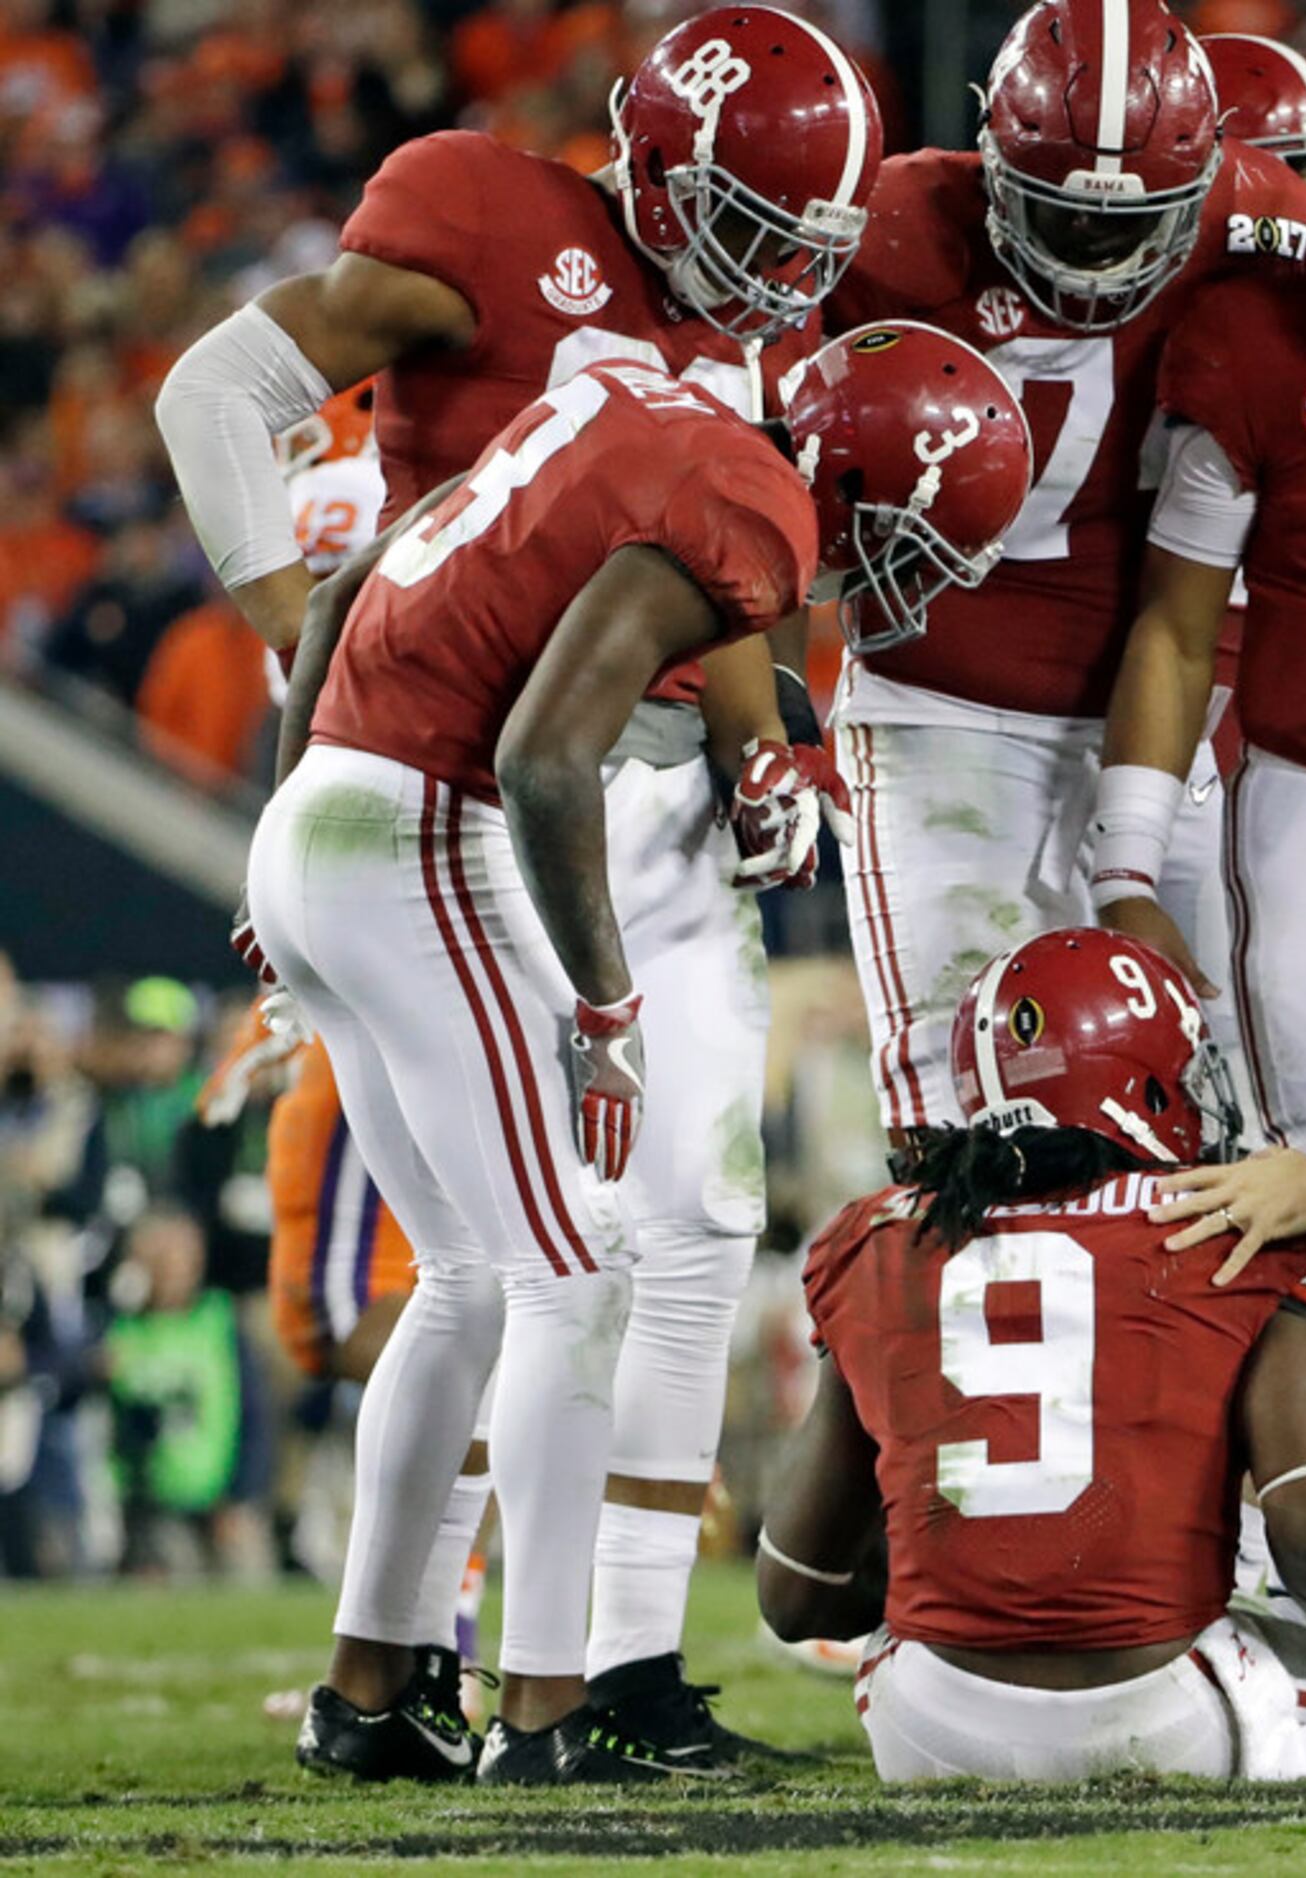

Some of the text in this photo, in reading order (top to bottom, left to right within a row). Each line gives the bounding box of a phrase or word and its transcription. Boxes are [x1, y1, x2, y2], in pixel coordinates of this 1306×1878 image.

[672, 39, 751, 118] 88
[555, 247, 598, 297] SEC
[976, 287, 1024, 336] SEC
[914, 405, 981, 465] 3
[378, 373, 609, 588] 3
[1109, 954, 1157, 1020] 9
[936, 1231, 1096, 1519] 9
